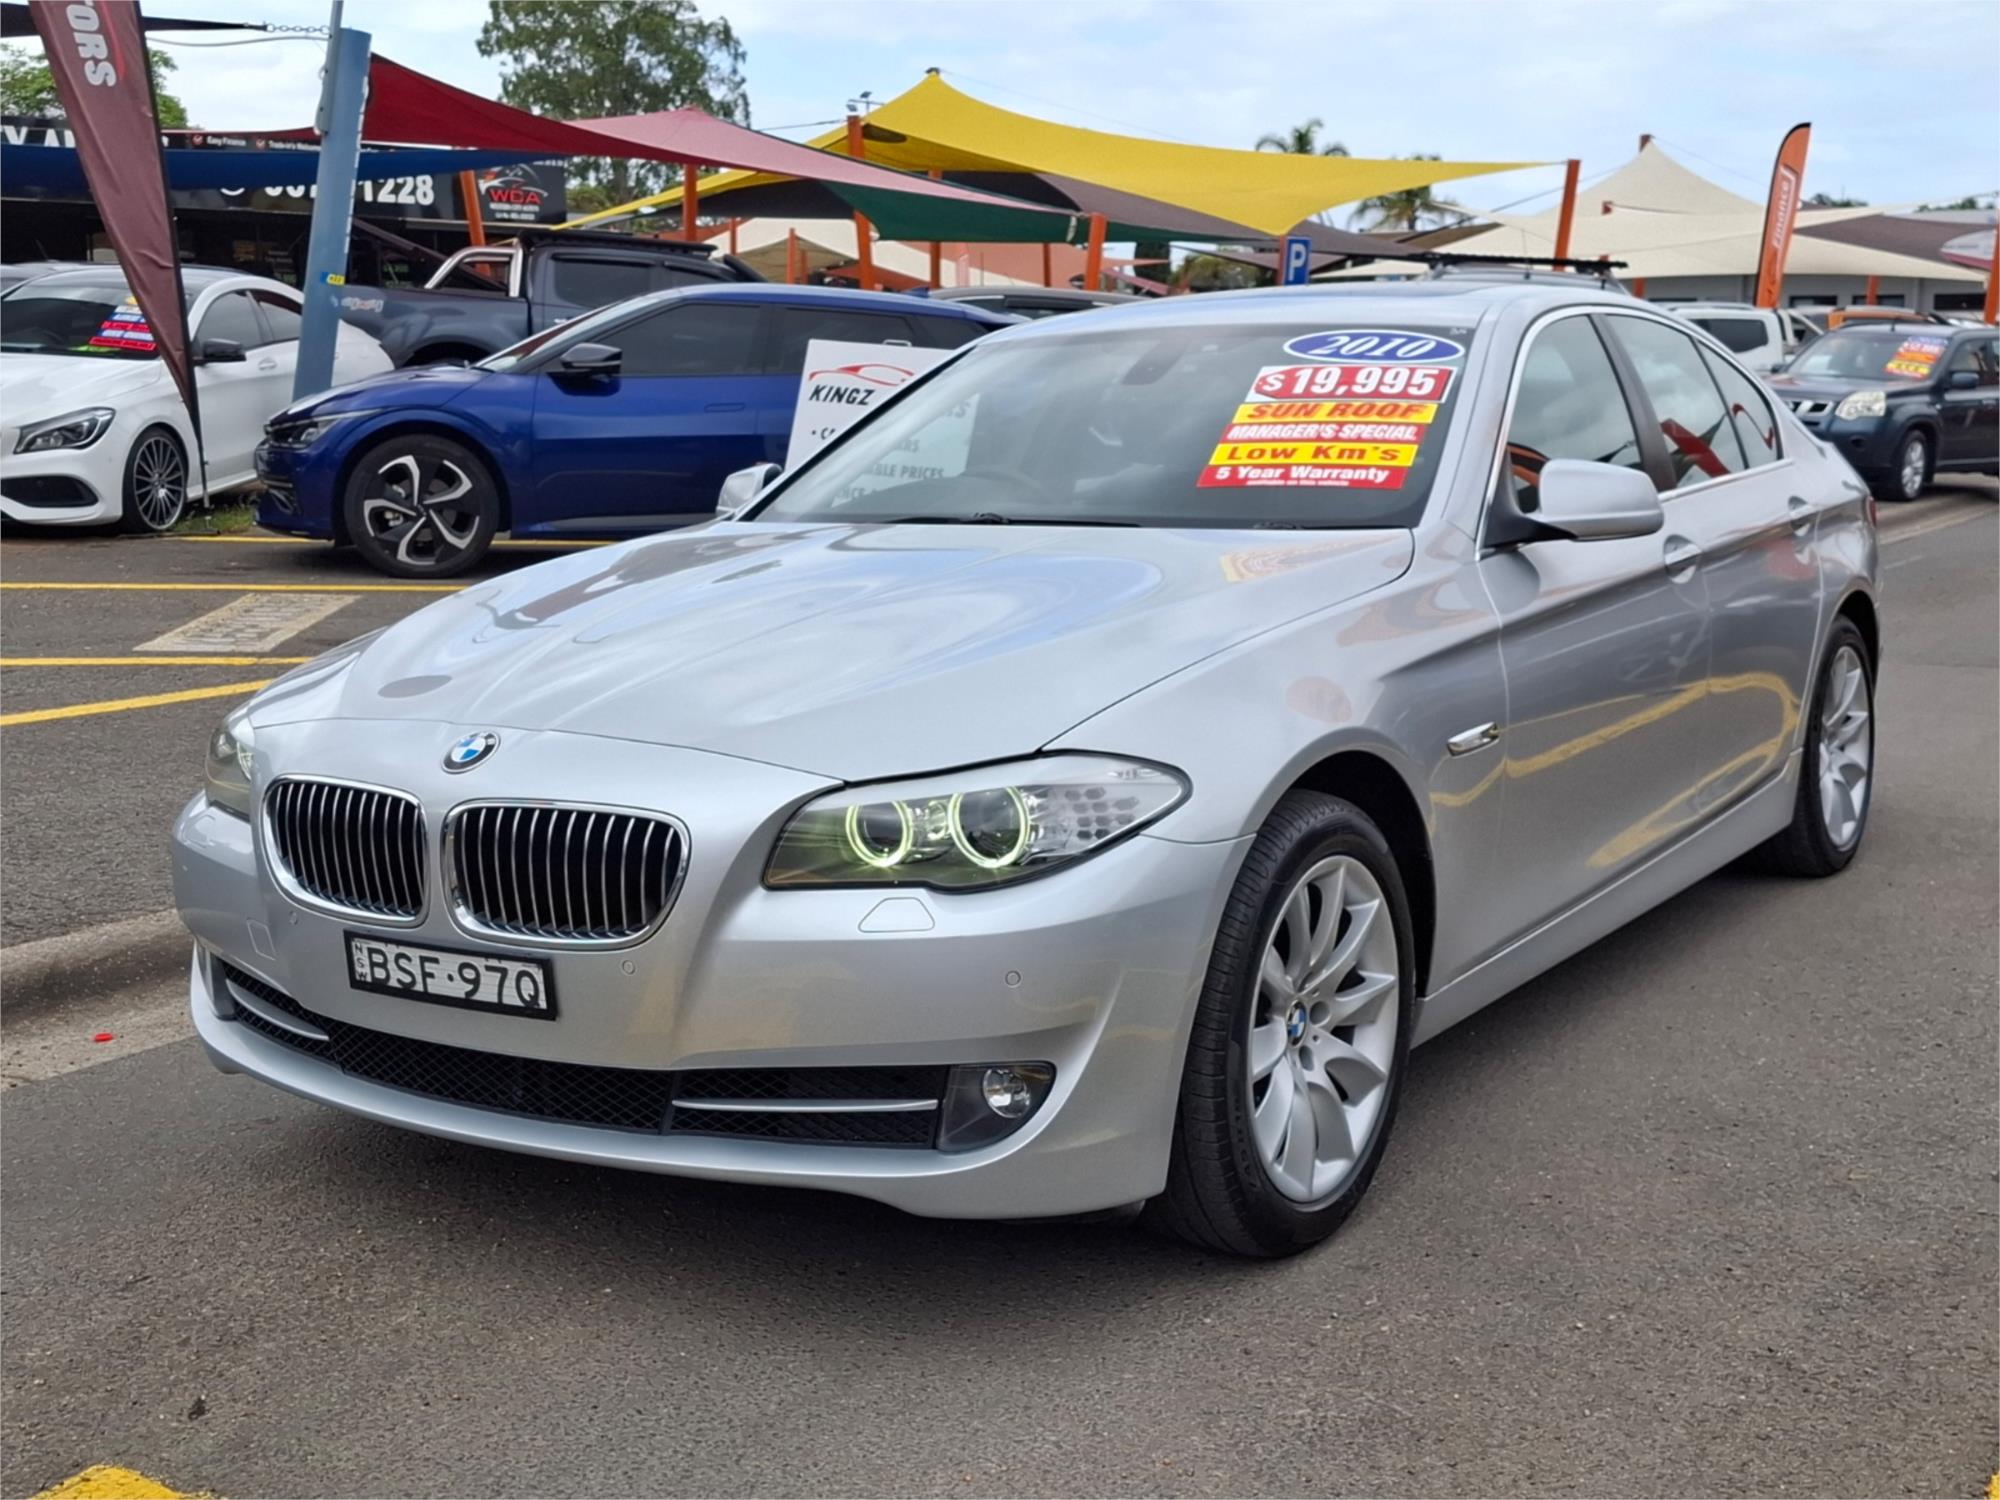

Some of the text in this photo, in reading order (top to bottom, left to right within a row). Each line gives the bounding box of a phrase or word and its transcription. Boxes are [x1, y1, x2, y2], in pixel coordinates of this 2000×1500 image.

[66, 0, 116, 87] ORS
[489, 187, 542, 205] WCA
[1288, 243, 1307, 282] P
[1308, 335, 1437, 358] 2010
[808, 384, 876, 406] KINGZ
[1247, 402, 1429, 420] SUN ROOF
[1226, 423, 1417, 441] MANAGER'S SPECIAL
[1215, 465, 1390, 484] 5 Year Warranty
